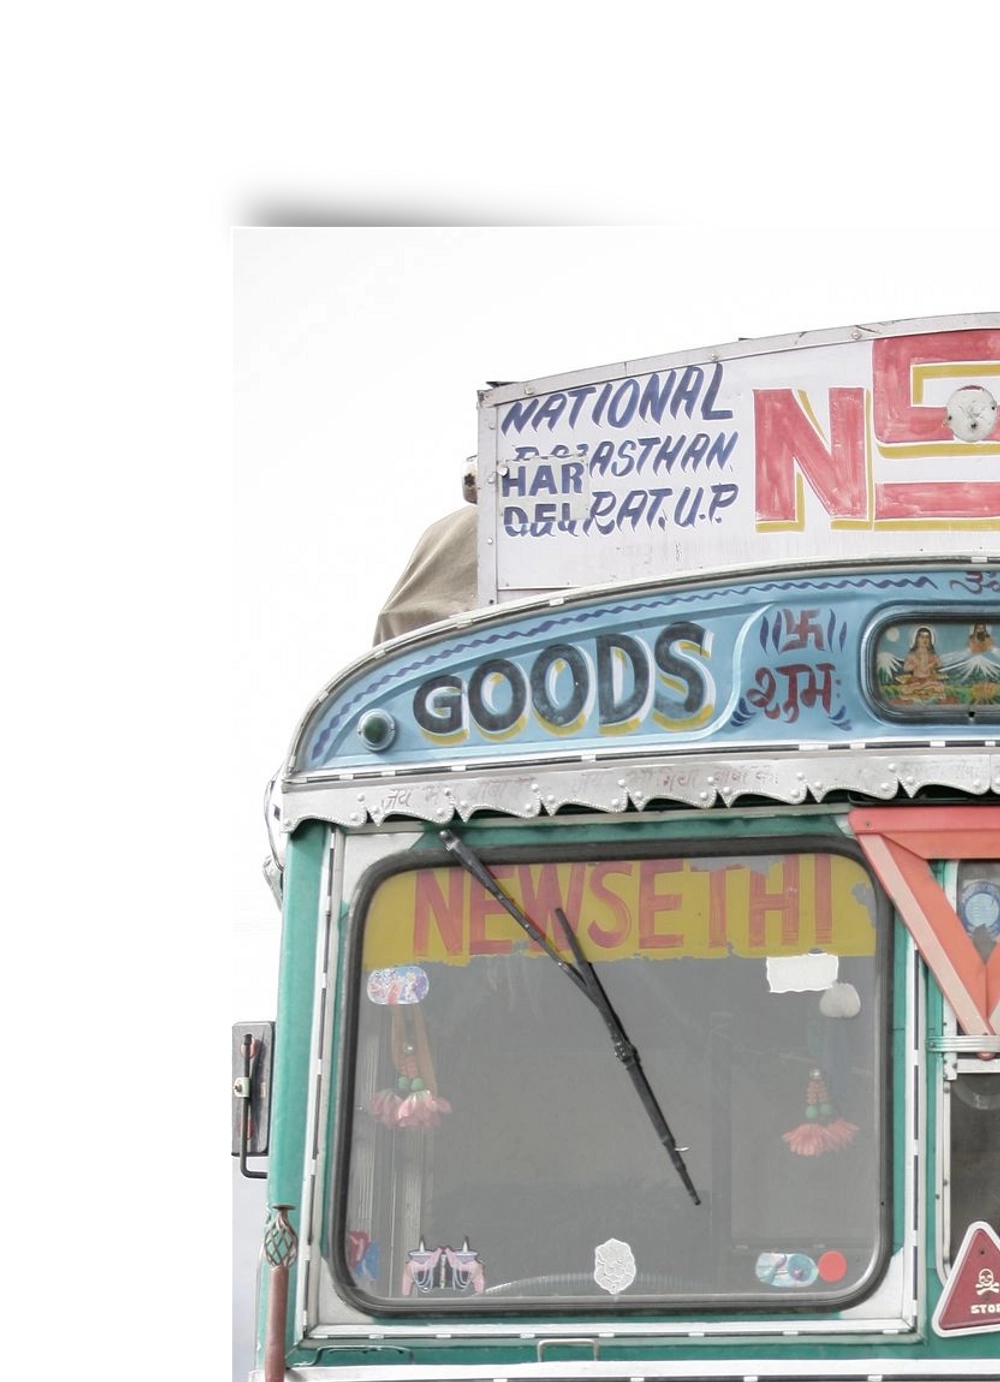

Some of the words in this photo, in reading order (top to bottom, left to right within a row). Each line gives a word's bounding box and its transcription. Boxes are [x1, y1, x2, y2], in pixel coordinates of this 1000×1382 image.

[501, 362, 734, 436] NATIONAL
[501, 462, 587, 498] HAR
[413, 621, 716, 745] GOODS
